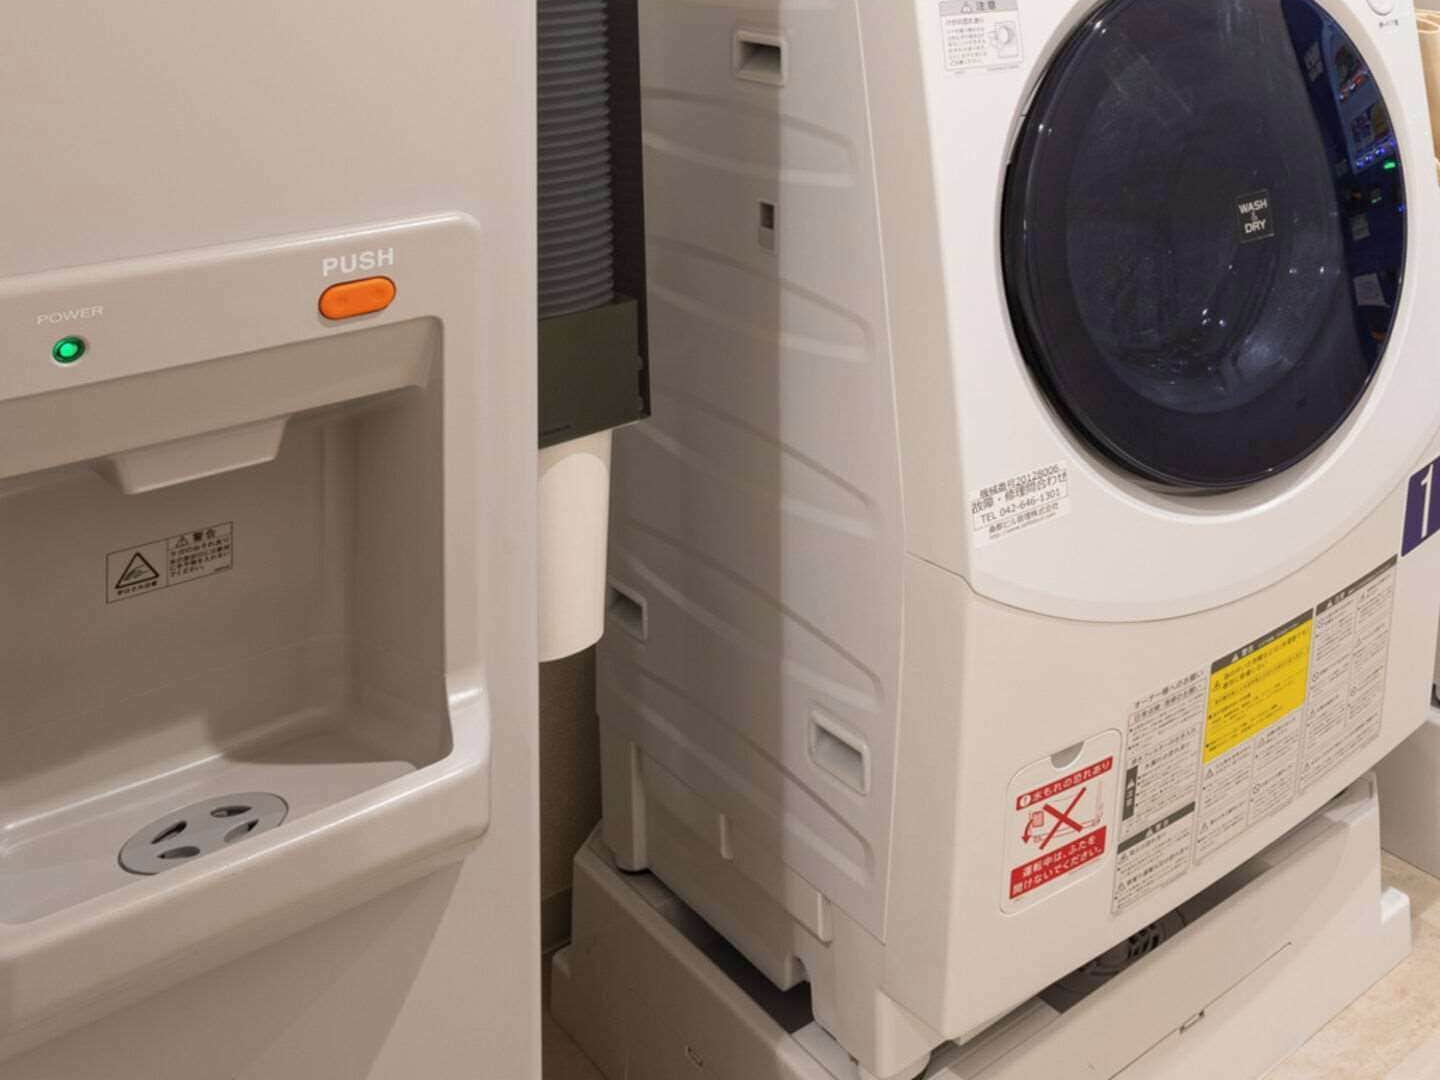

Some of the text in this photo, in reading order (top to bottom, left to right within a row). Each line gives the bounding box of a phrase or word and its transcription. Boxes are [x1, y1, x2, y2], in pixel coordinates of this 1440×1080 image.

[1239, 198, 1267, 214] WASH
[1244, 219, 1266, 233] DRY
[322, 248, 394, 276] PUSH
[37, 305, 104, 325] POWER
[1420, 463, 1433, 540] 1
[981, 512, 997, 523] TEL
[1032, 760, 1110, 802] 水もれの恐れあり
